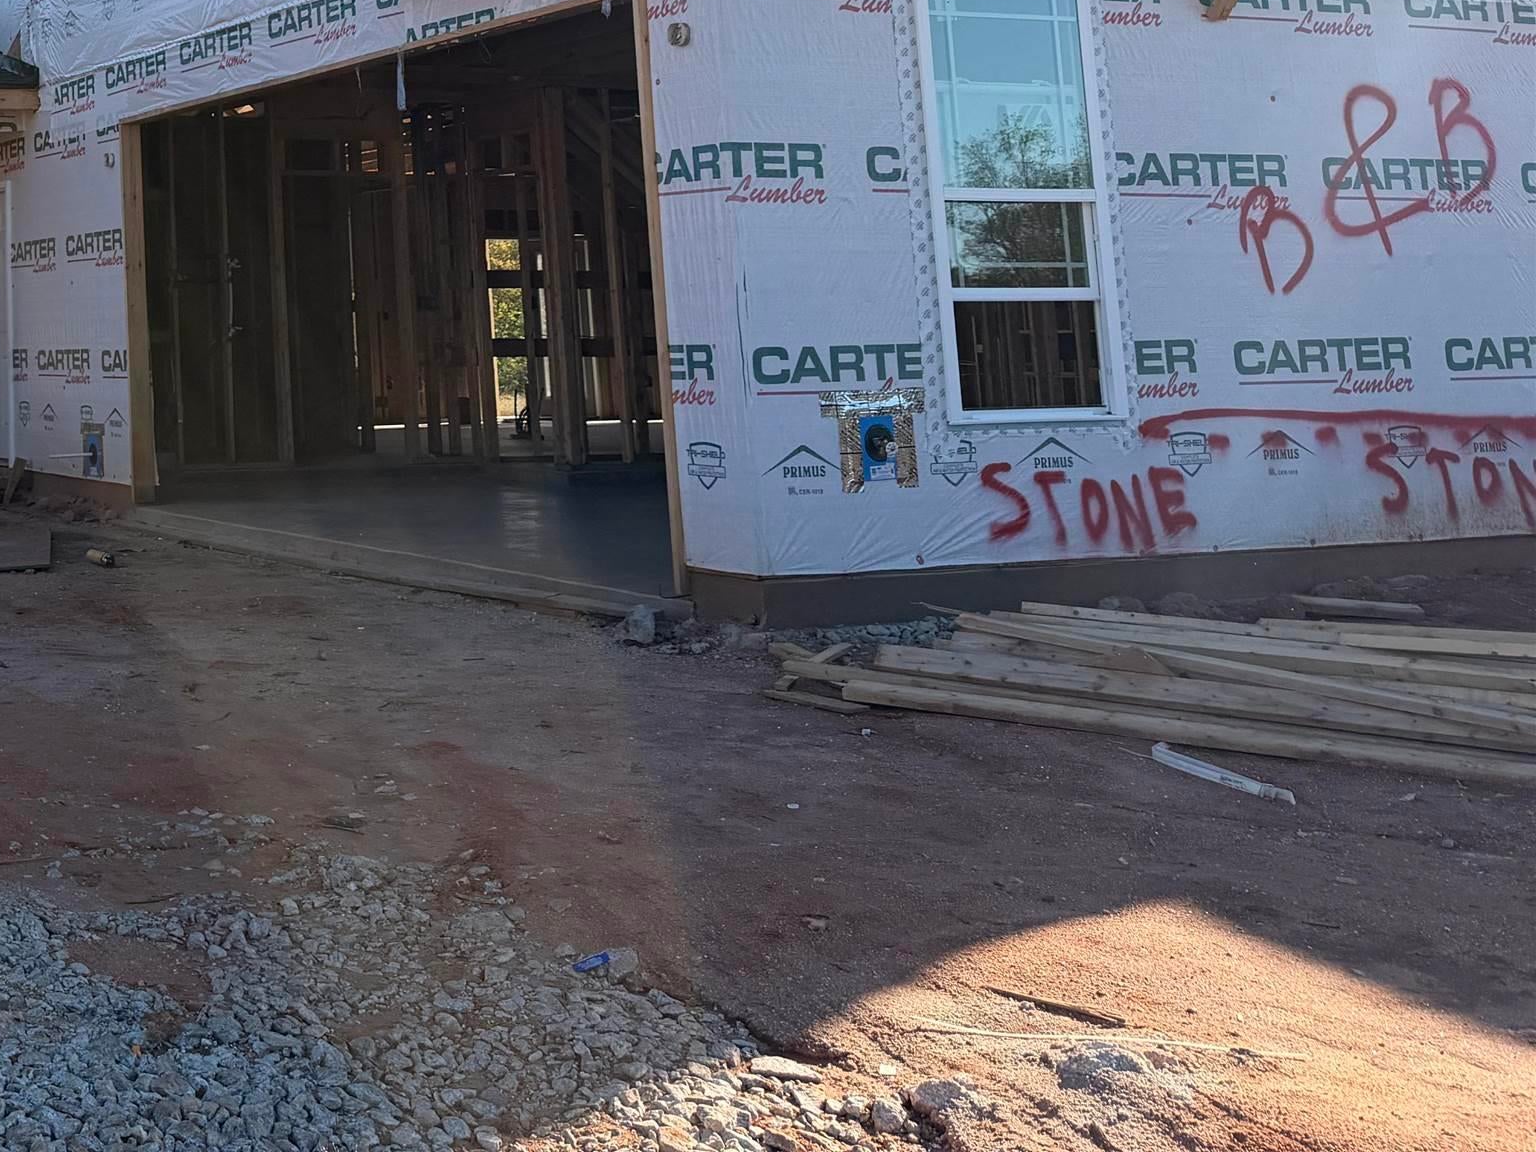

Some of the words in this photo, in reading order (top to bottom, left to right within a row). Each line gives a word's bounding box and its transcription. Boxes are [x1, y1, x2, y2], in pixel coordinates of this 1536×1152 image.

[314, 18, 357, 44] Lumber
[1102, 1, 1162, 27] umber
[1294, 8, 1374, 38] Lumber
[54, 75, 95, 105] ARTER
[105, 51, 166, 89] CARTER
[179, 21, 252, 65] CARTER
[725, 174, 828, 205] Lumber
[1321, 156, 1490, 192] CARTER
[66, 228, 123, 257] CARTER
[38, 350, 90, 370] CARTER
[752, 343, 923, 386] CARTE
[1233, 336, 1412, 375] CARTER
[1138, 367, 1199, 399] umber
[1332, 367, 1415, 395] Lumber
[1033, 456, 1074, 469] PRIMUS
[1264, 448, 1300, 461] PRIMUS
[1473, 441, 1508, 454] PRIMUS
[783, 465, 826, 479] PRIMUS
[1365, 441, 1536, 530] STON
[979, 460, 1198, 552] STONE
